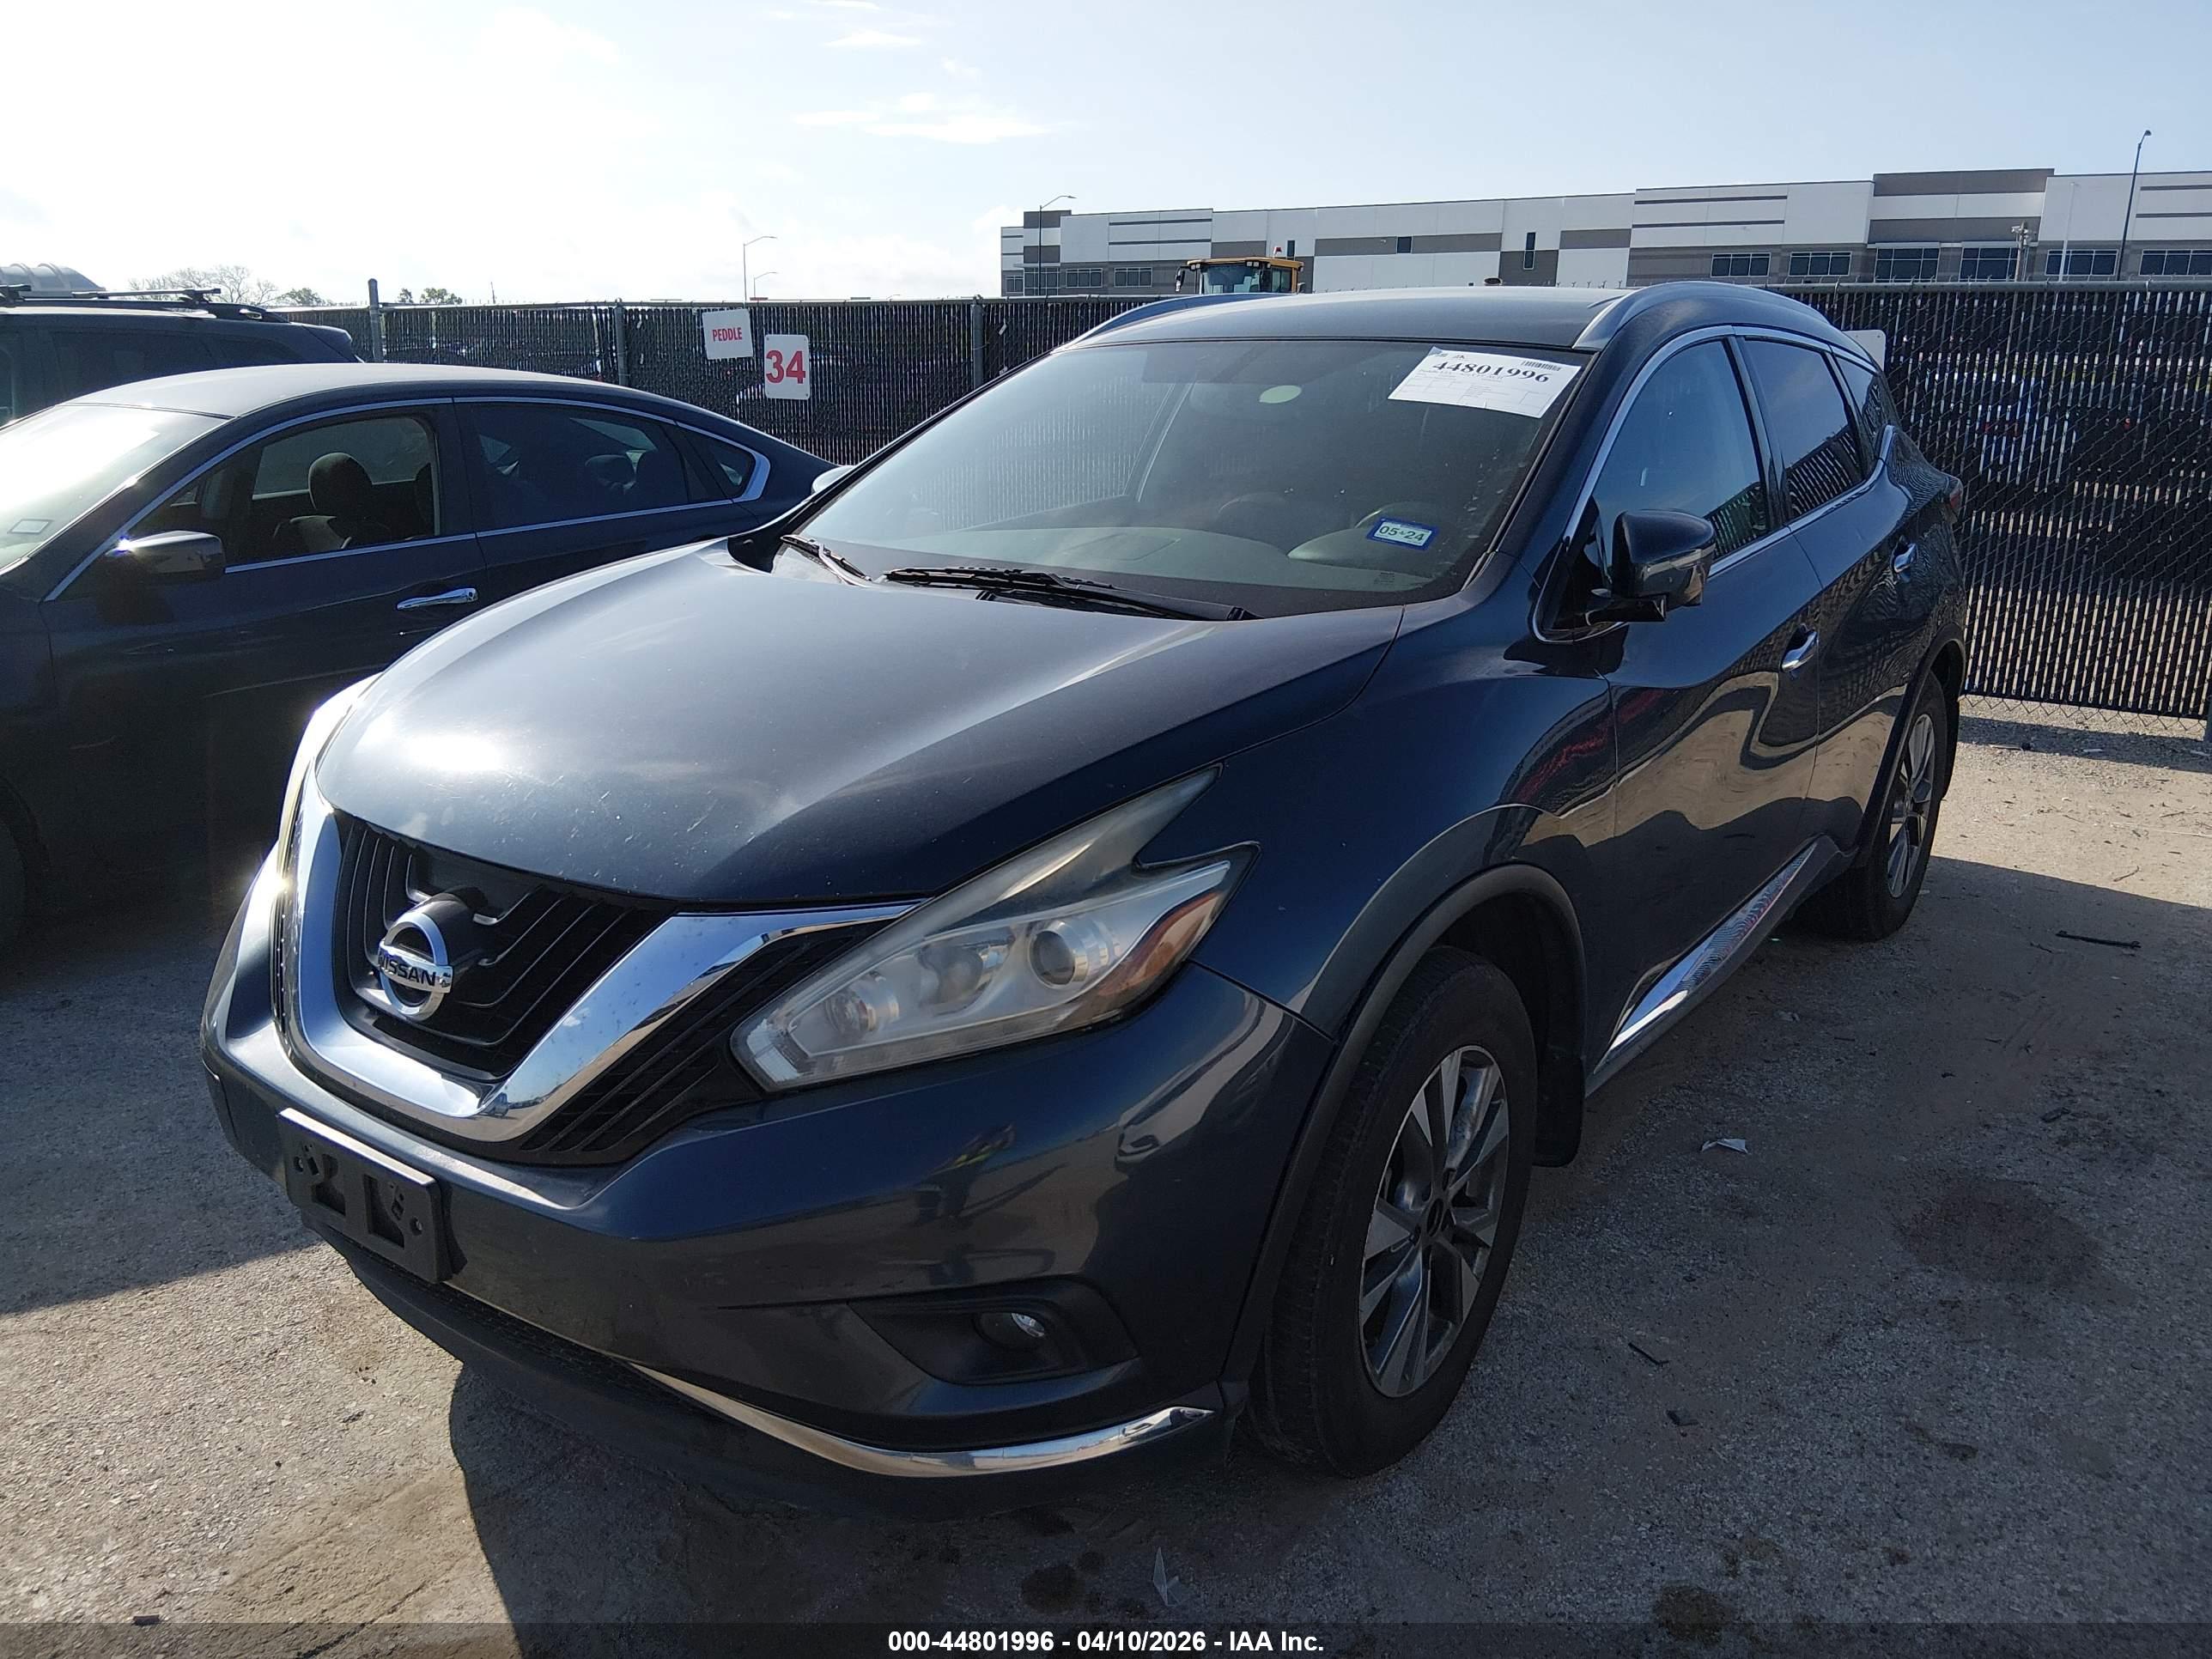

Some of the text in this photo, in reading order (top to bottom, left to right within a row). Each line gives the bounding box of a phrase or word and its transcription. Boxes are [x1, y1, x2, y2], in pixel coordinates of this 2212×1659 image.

[712, 327, 743, 342] PEDDLE
[766, 349, 806, 385] 34
[1432, 362, 1549, 383] 44801996
[378, 954, 436, 987] NISSAN
